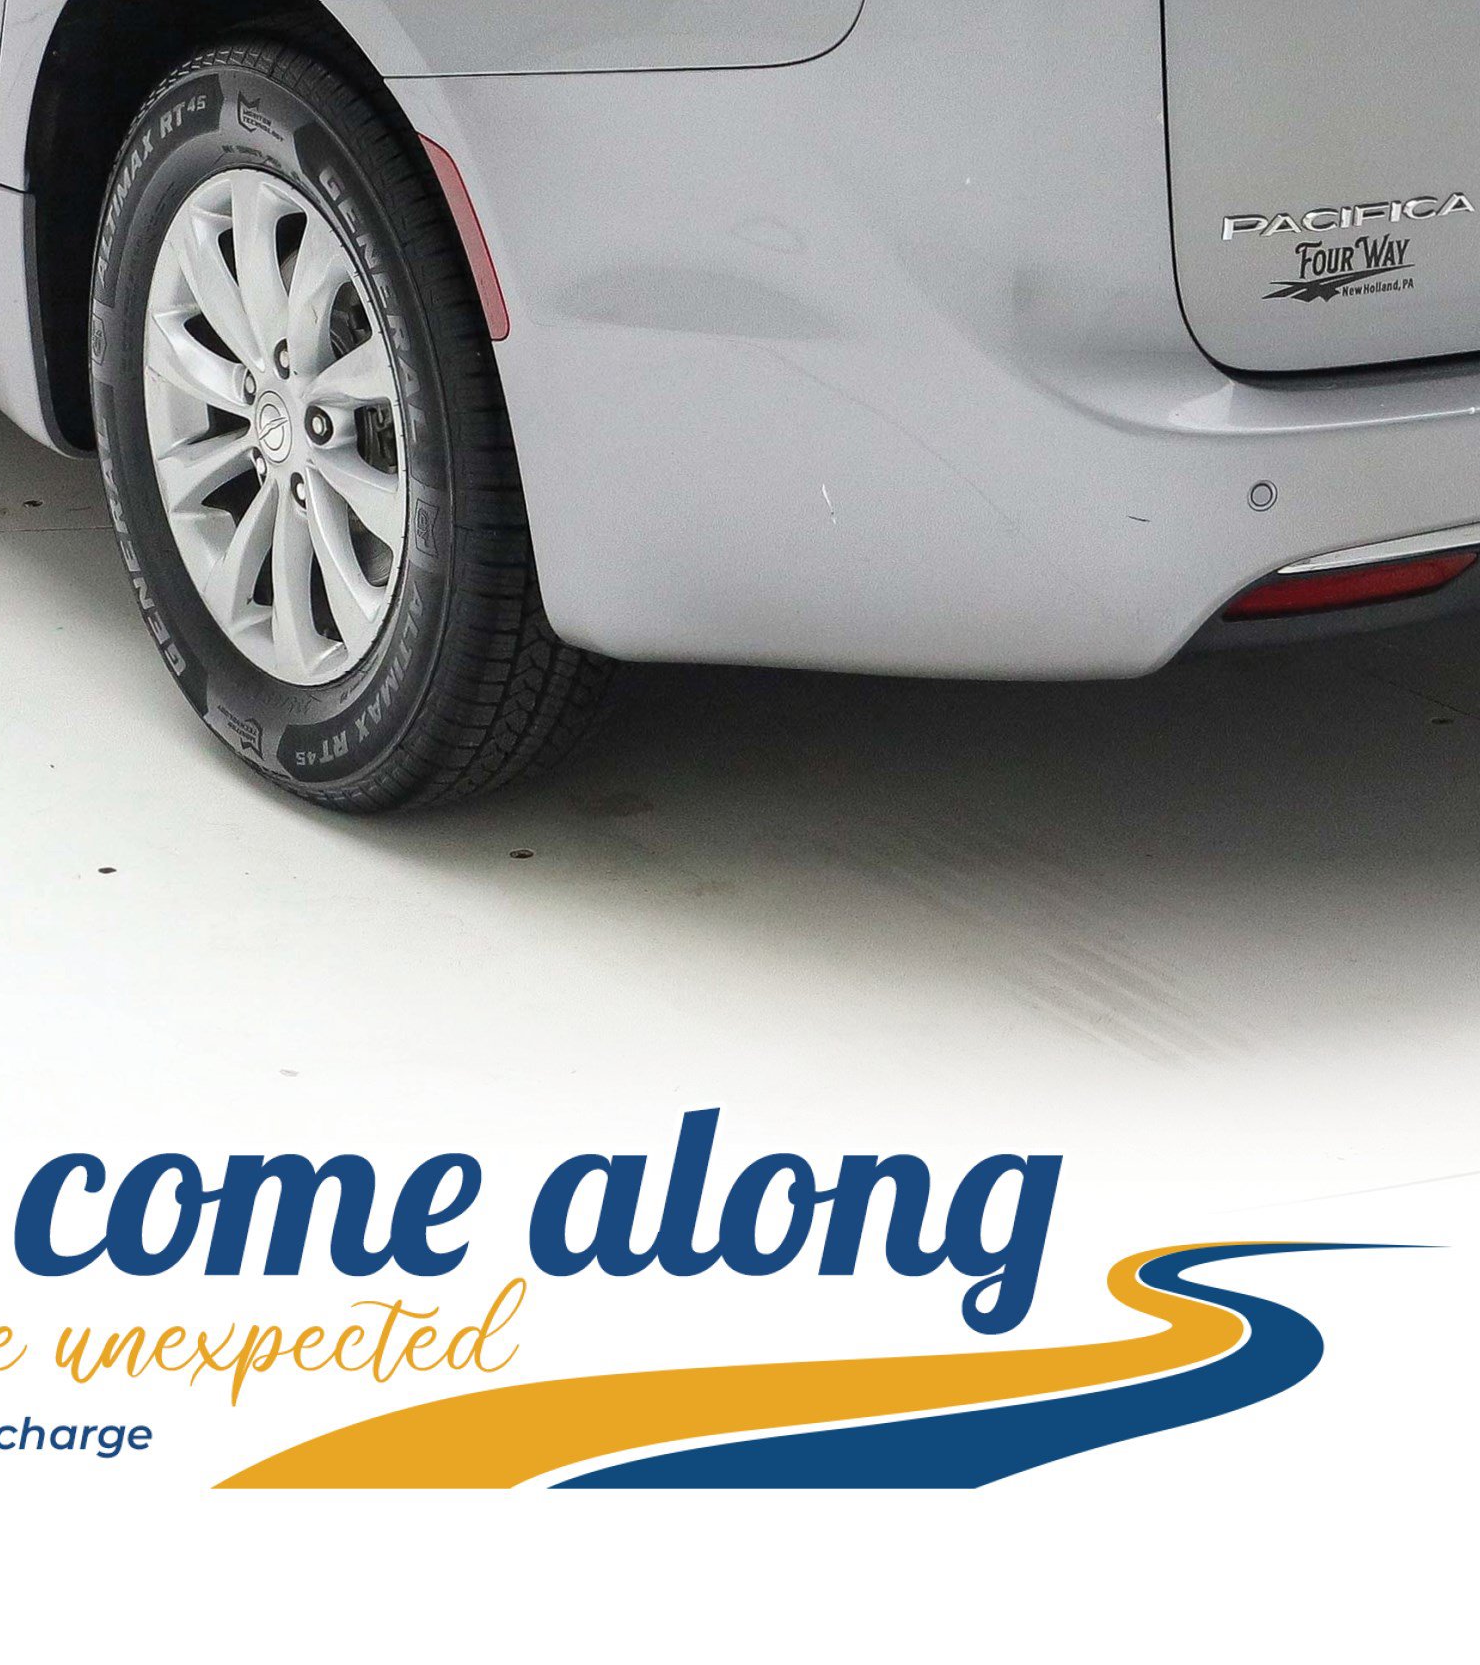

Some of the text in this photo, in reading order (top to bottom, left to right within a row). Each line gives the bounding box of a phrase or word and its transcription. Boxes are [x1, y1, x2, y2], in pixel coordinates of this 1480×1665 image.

[97, 128, 154, 289] ALTIMAX
[1221, 192, 1476, 241] PACIFICA
[1295, 233, 1411, 279] FOUR WAY
[319, 164, 426, 445] GENERAL
[1402, 278, 1415, 290] PA
[355, 581, 425, 744] ALTIMAX
